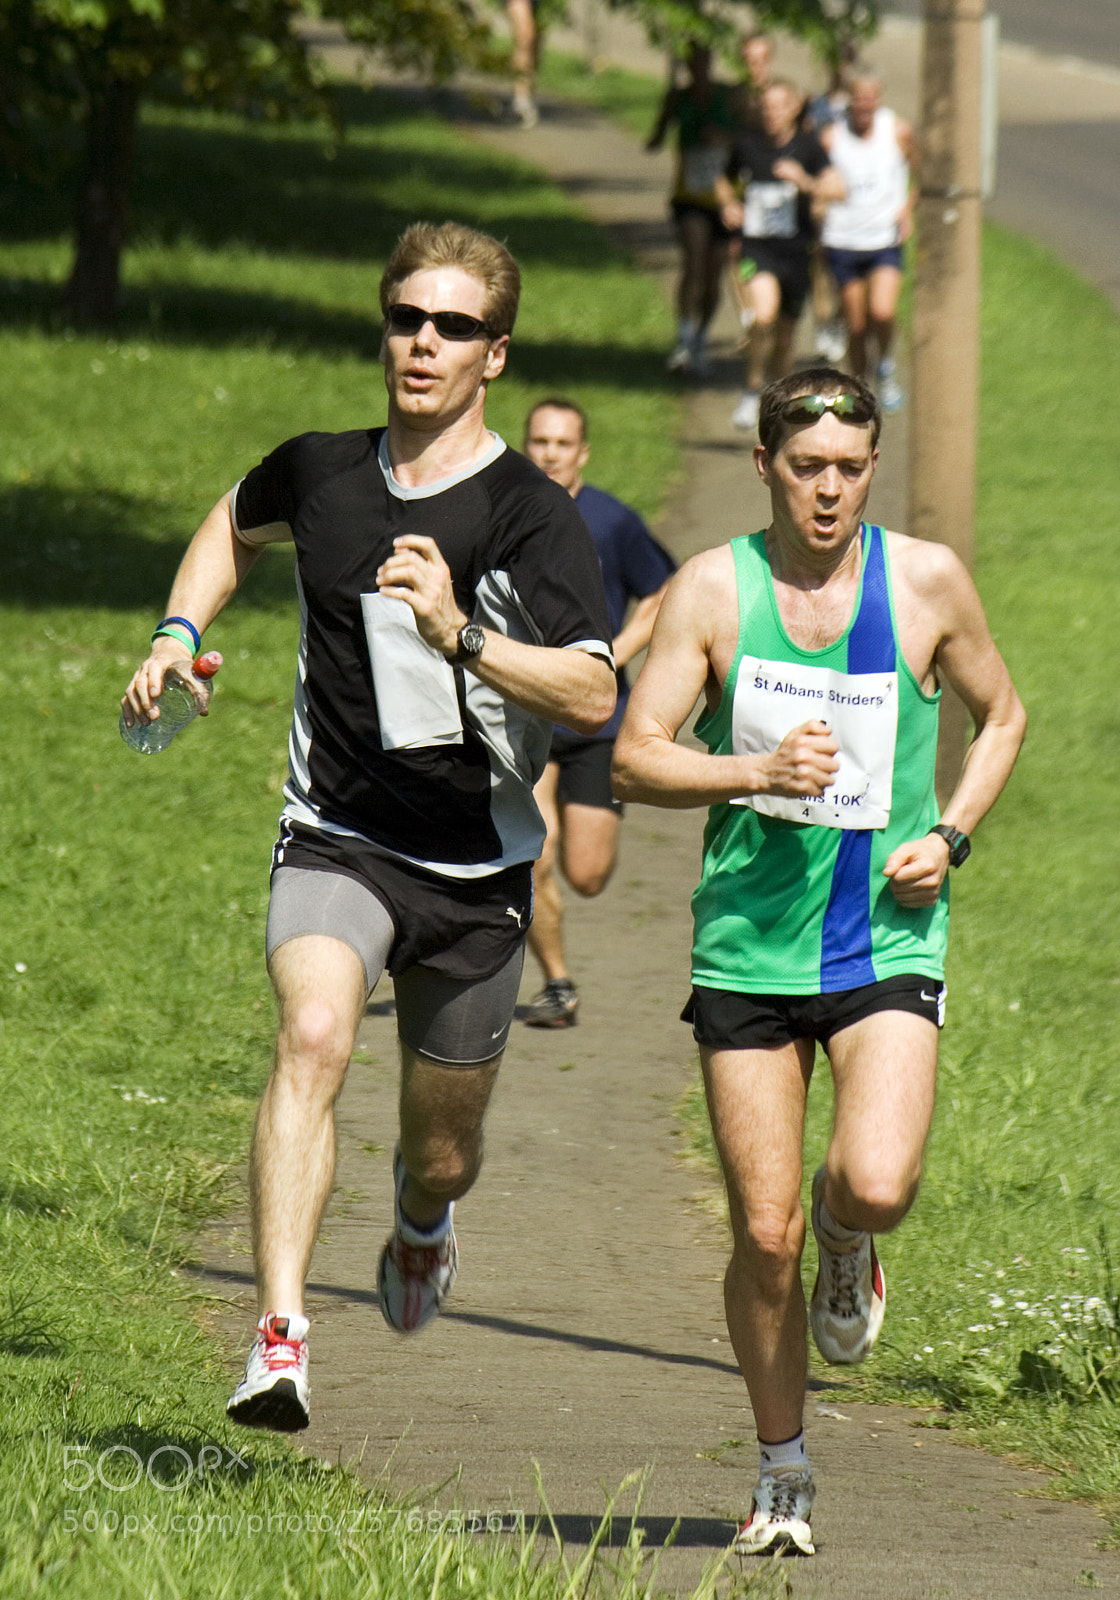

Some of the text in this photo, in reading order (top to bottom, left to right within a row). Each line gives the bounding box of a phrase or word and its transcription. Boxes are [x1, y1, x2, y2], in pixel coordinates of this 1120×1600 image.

[754, 676, 884, 706] St Albans Striders
[833, 794, 862, 806] 10K
